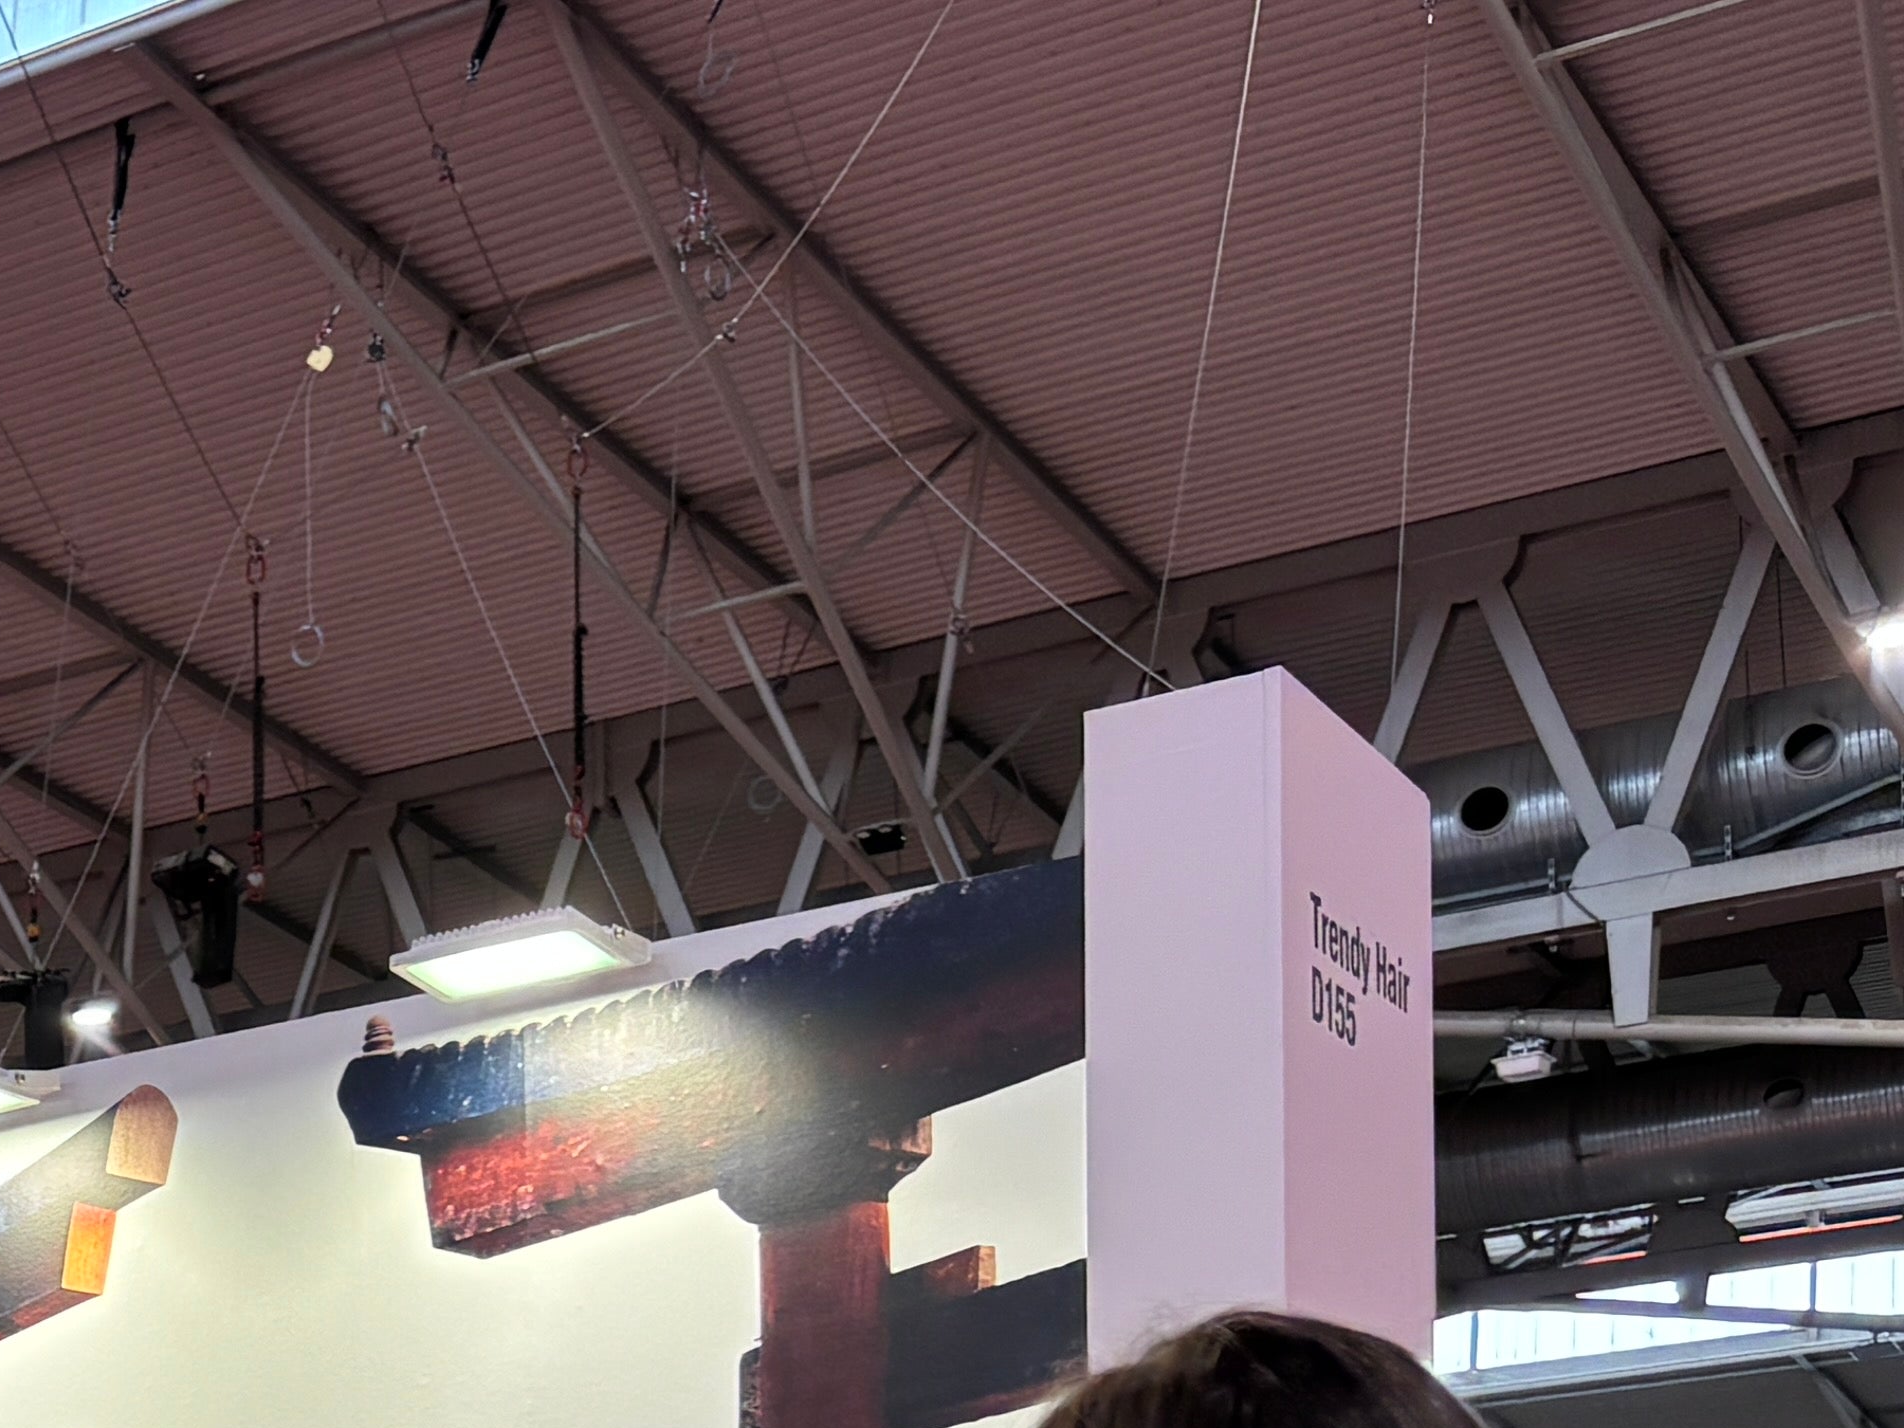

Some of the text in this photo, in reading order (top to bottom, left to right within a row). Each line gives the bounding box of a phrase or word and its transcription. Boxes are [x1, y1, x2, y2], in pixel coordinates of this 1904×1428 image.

[1310, 891, 1410, 1013] Trendy Hair
[1311, 965, 1356, 1047] D155
